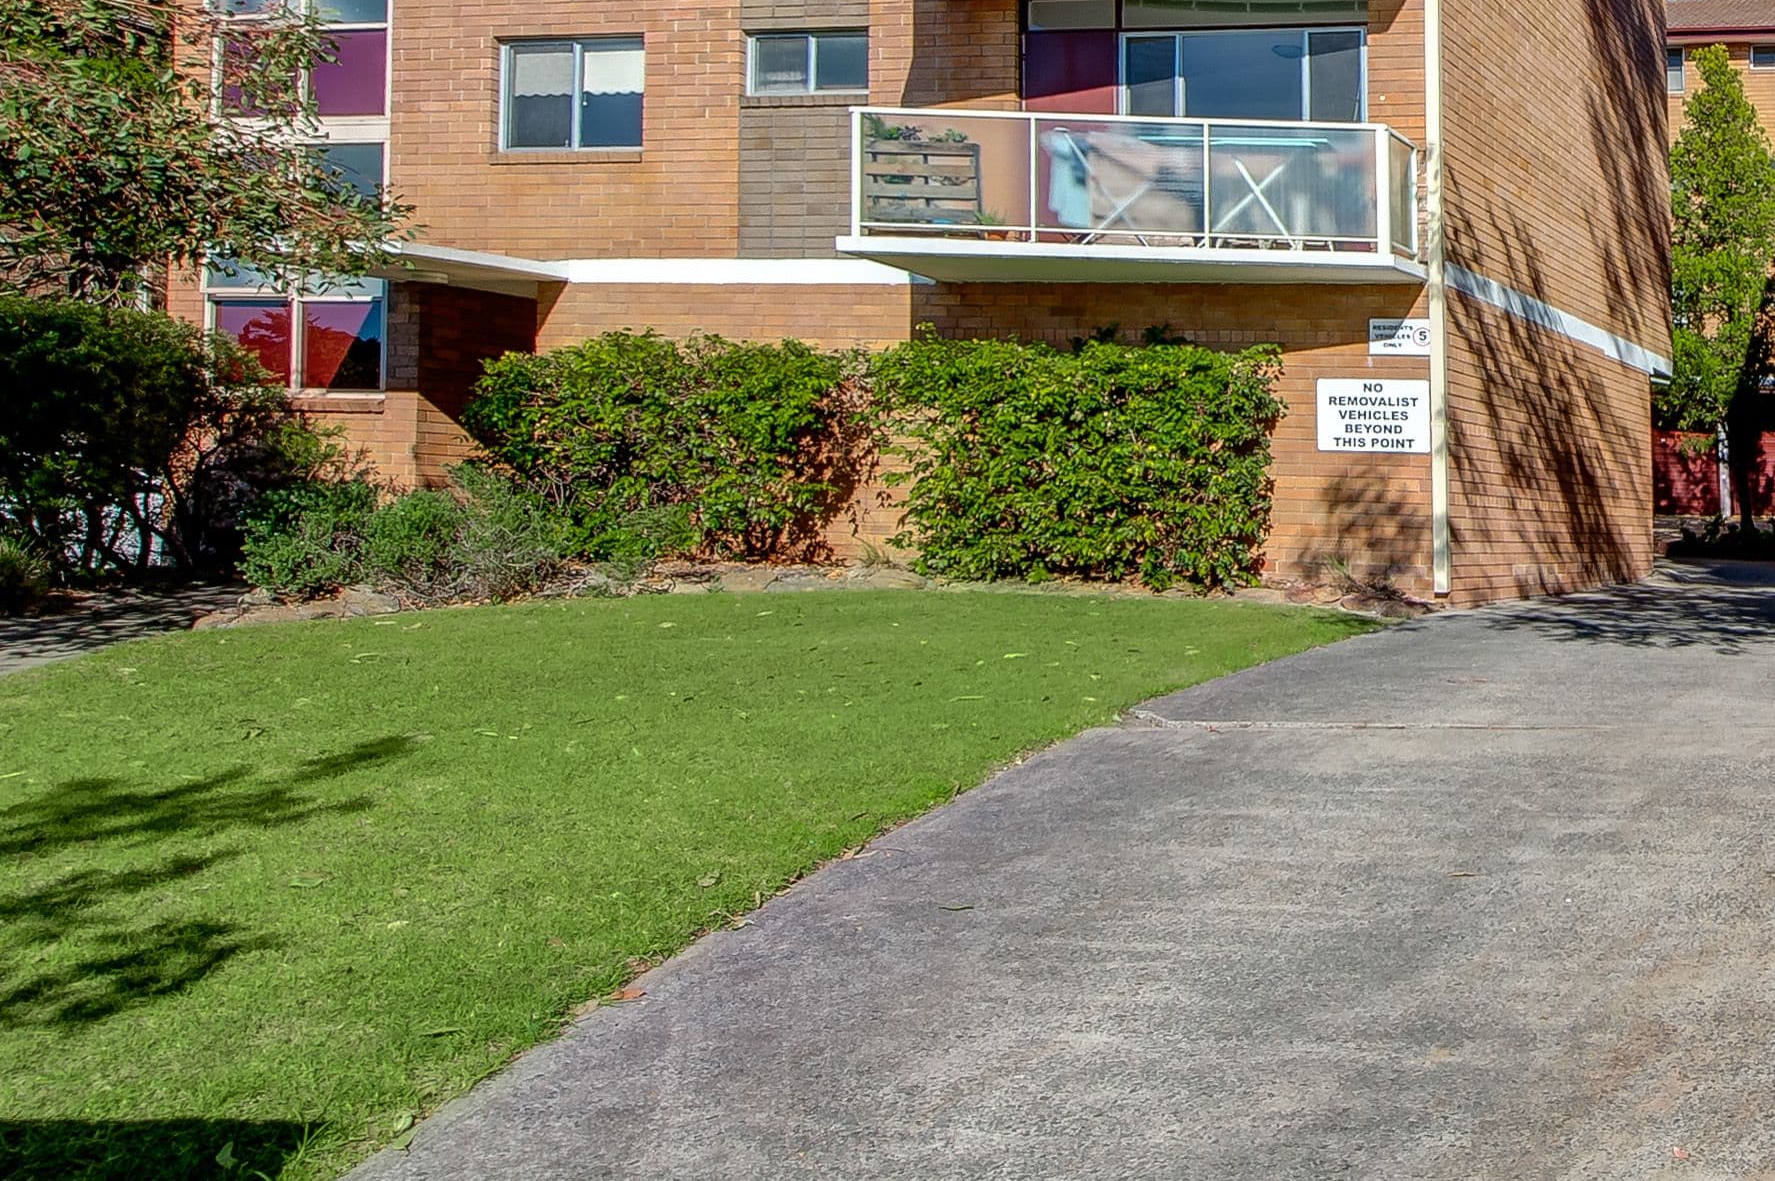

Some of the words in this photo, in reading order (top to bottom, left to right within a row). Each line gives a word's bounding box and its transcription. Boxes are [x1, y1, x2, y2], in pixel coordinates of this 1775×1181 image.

[1419, 330, 1427, 341] 5
[1363, 383, 1383, 393] NO
[1328, 396, 1419, 407] REMOVALIST
[1338, 410, 1409, 421] VEHICLES
[1345, 424, 1403, 434] BEYOND
[1334, 437, 1366, 448] THIS
[1371, 438, 1415, 449] POINT
